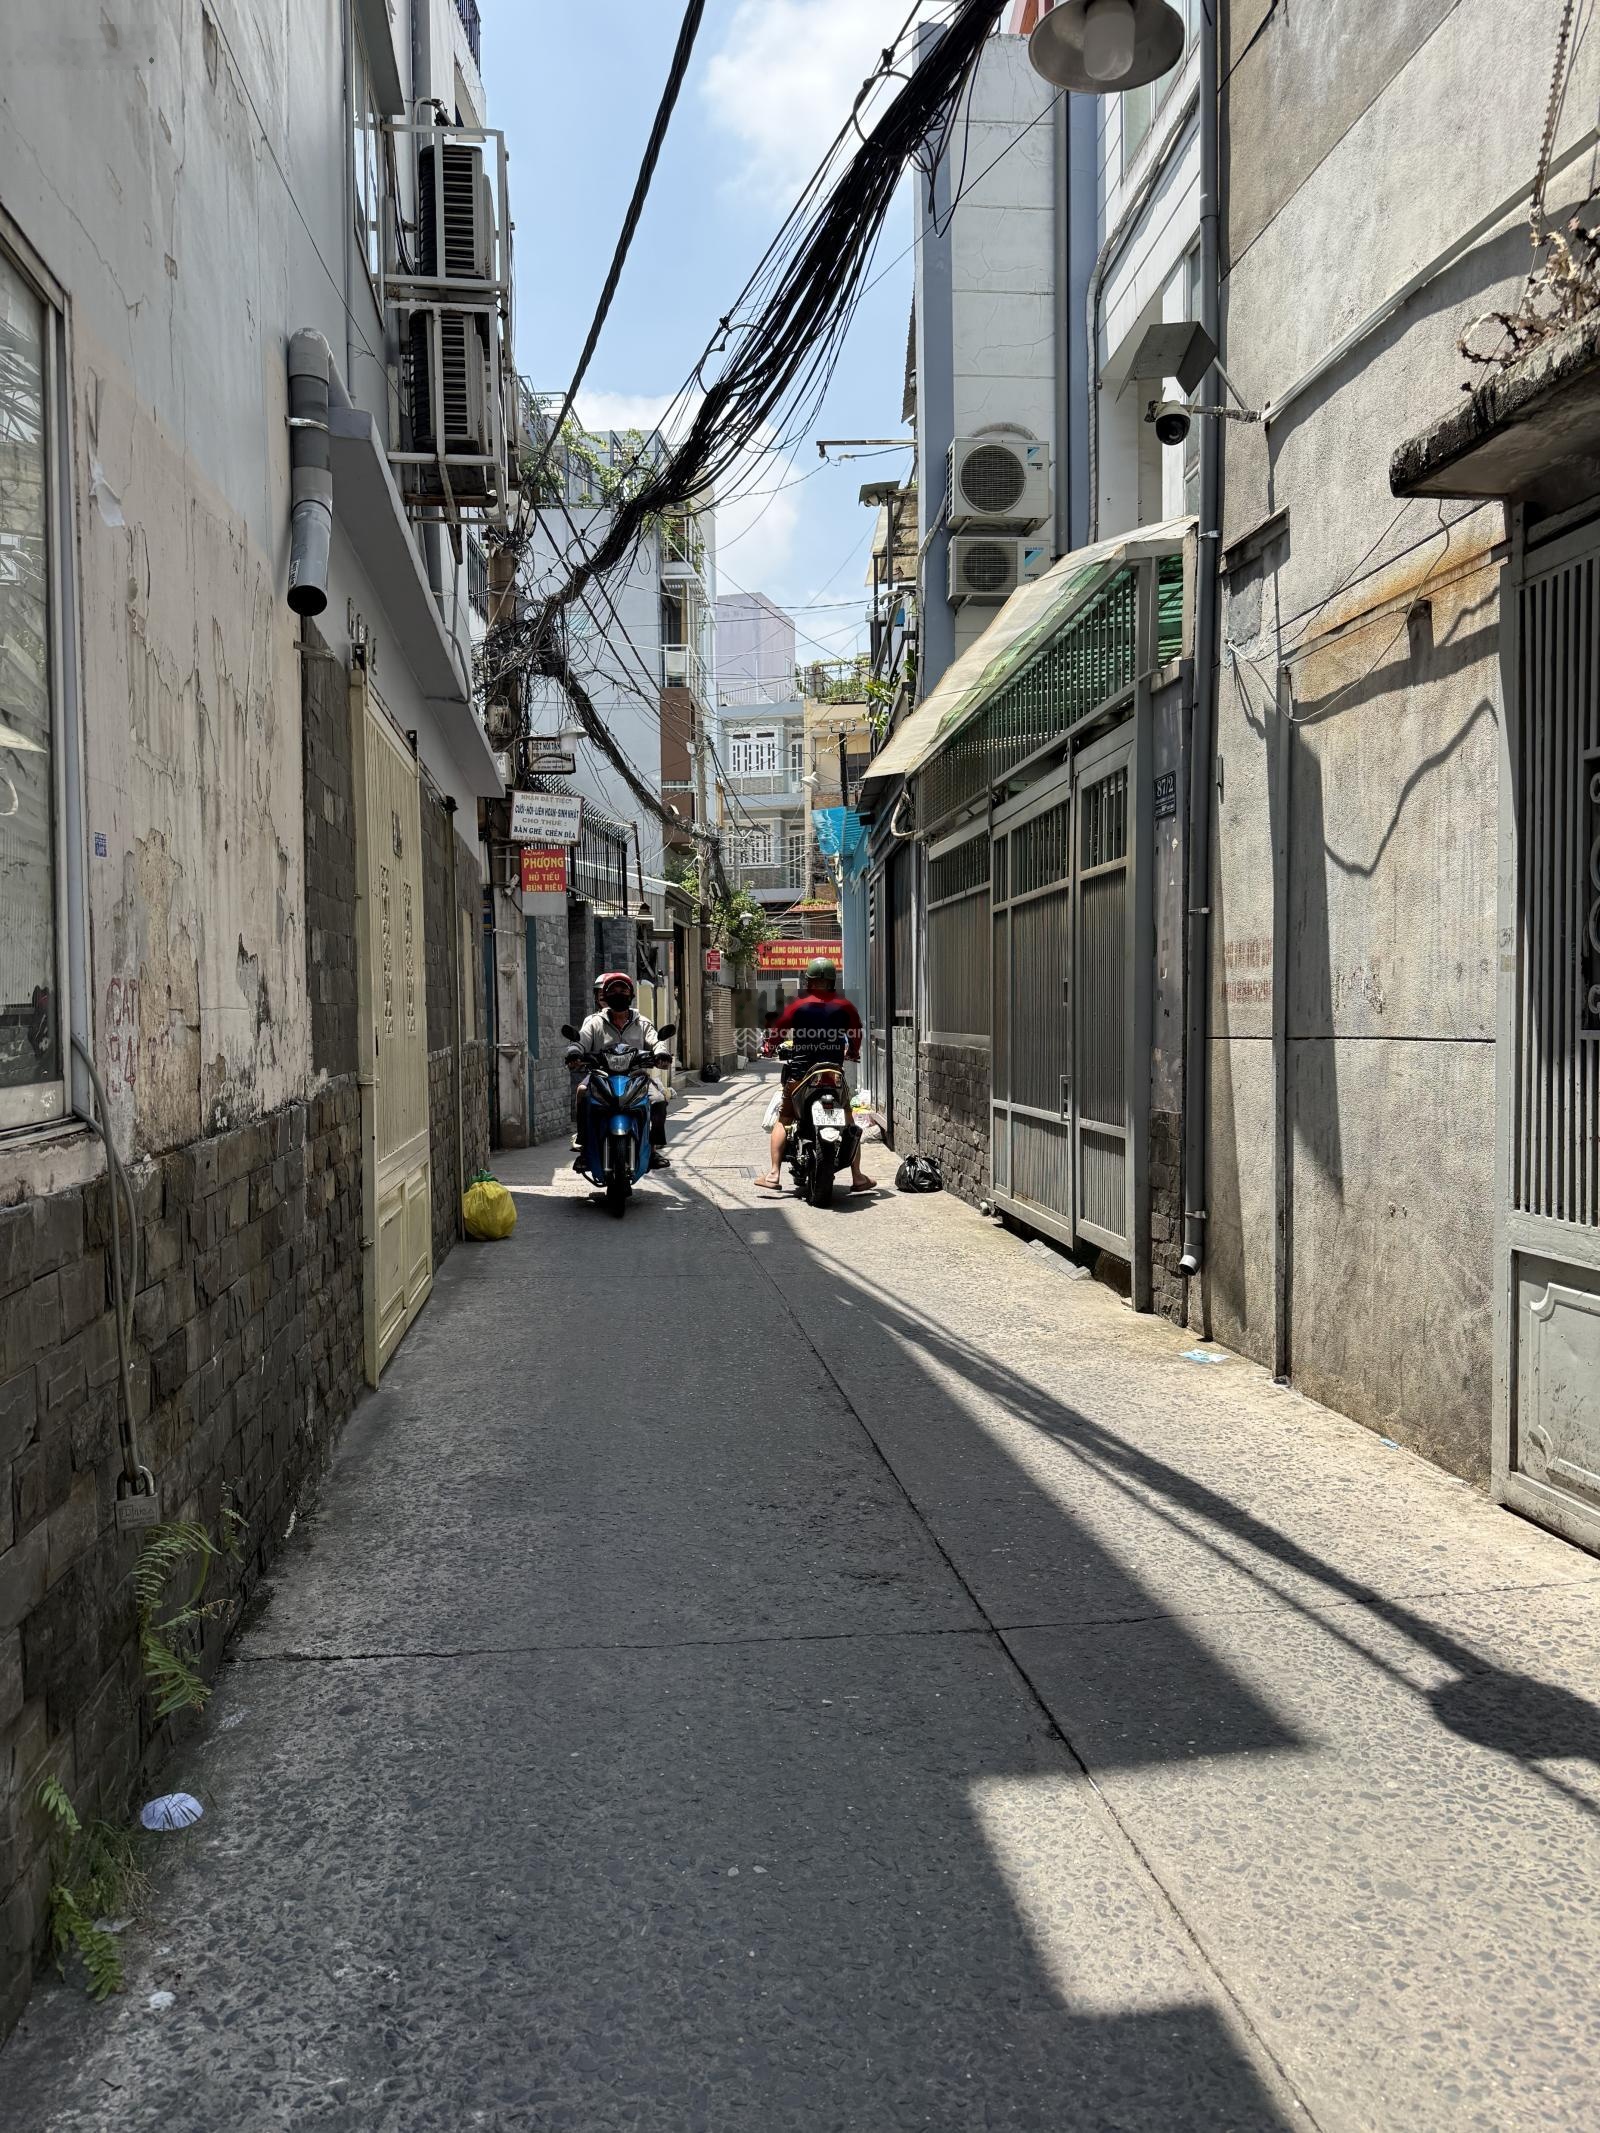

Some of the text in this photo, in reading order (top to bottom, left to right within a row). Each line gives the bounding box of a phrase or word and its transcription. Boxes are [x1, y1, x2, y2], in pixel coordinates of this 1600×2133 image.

[1156, 775, 1174, 797] 87/2
[513, 825, 528, 833] BÀN
[529, 827, 543, 835] GHẾ
[545, 828, 562, 837] CHÉN
[523, 856, 564, 870] PHƯỢNG
[542, 871, 560, 881] TIẾU
[526, 882, 563, 891] BÚN RIÊU
[787, 944, 802, 956] CỘNG
[803, 944, 815, 954] SẢN
[815, 944, 827, 955] VIỆT
[828, 945, 841, 954] NAM
[786, 957, 798, 967] MỌI
